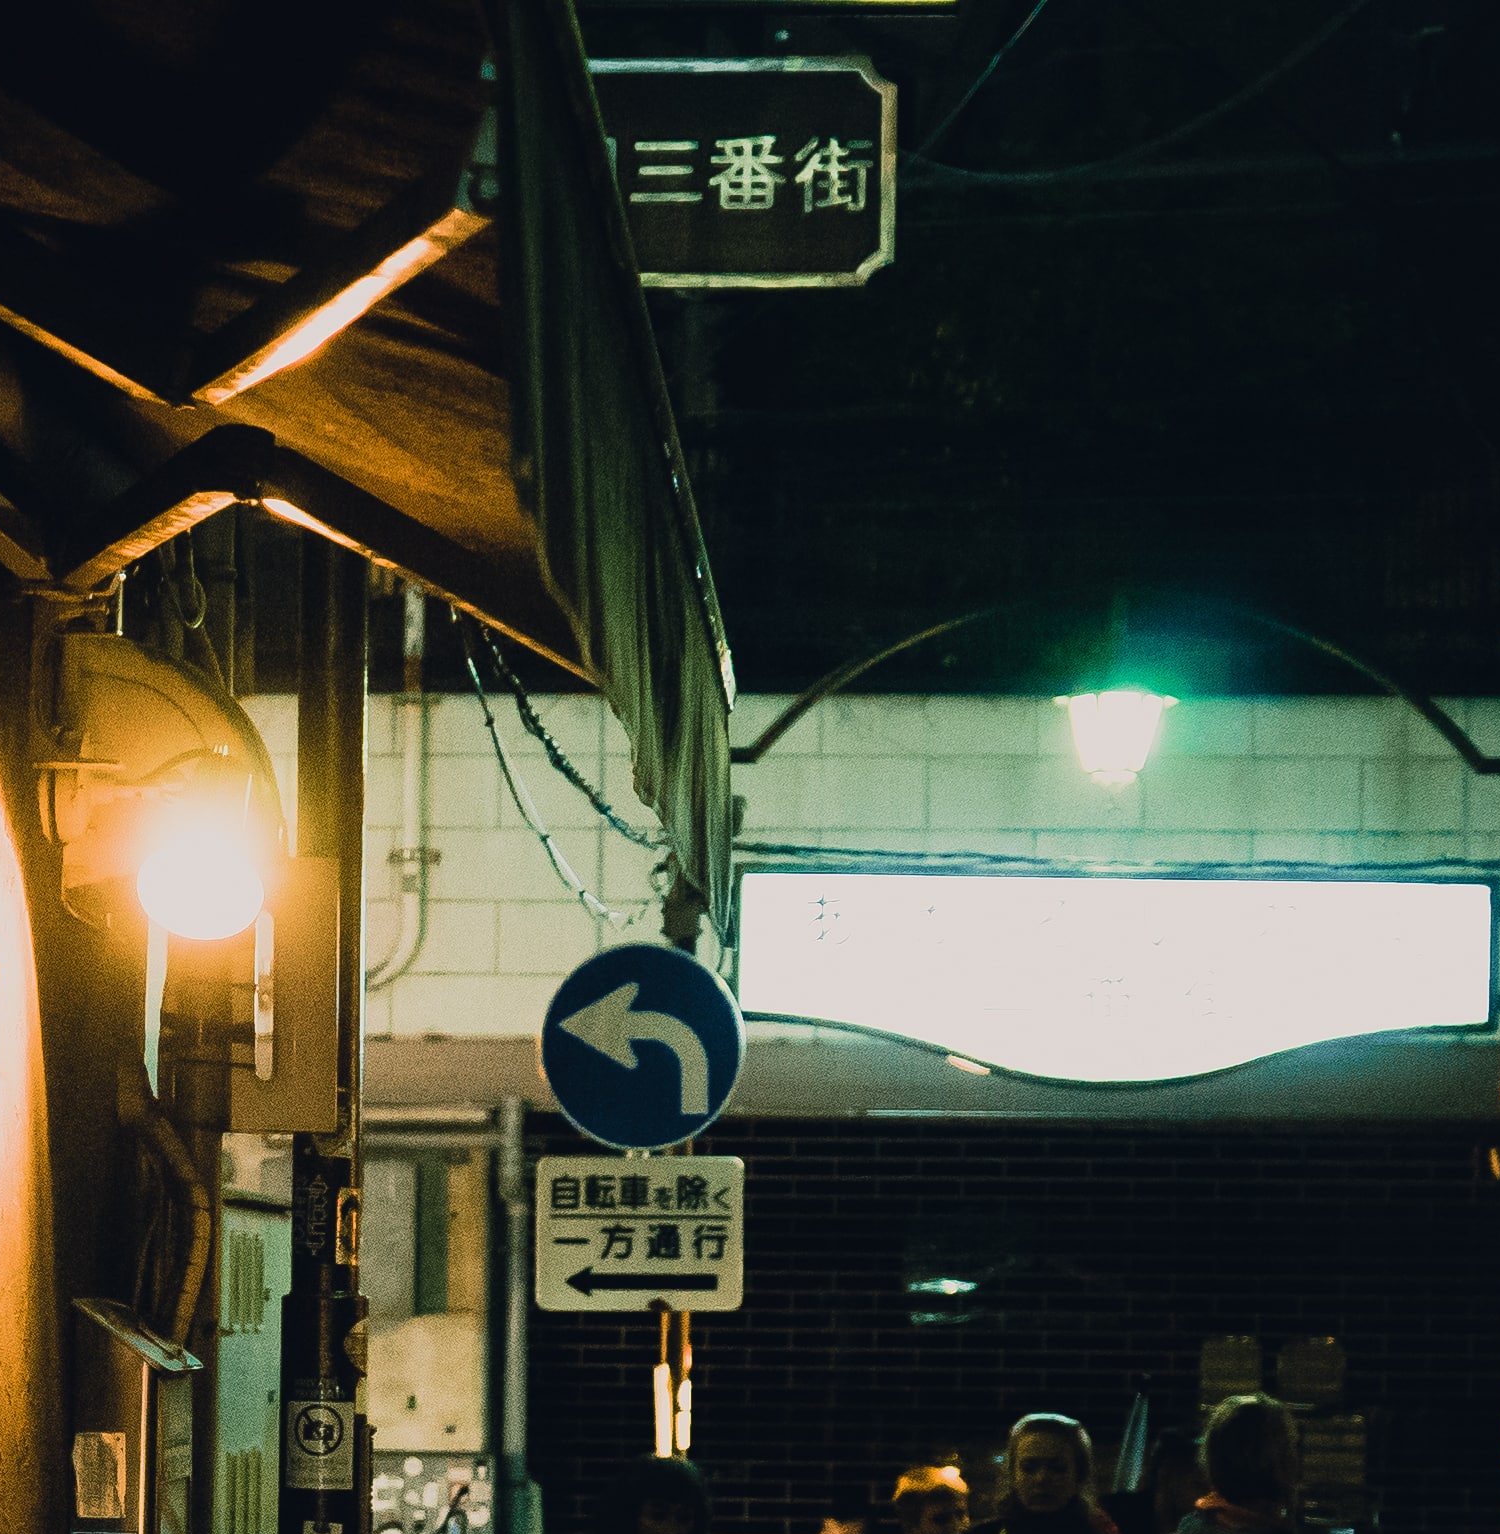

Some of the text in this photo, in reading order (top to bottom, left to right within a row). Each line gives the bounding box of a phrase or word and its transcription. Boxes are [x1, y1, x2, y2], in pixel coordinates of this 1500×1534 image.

[608, 135, 874, 213] 三番街
[551, 1174, 732, 1210] 自転車を除く
[553, 1224, 728, 1260] 一方通行
